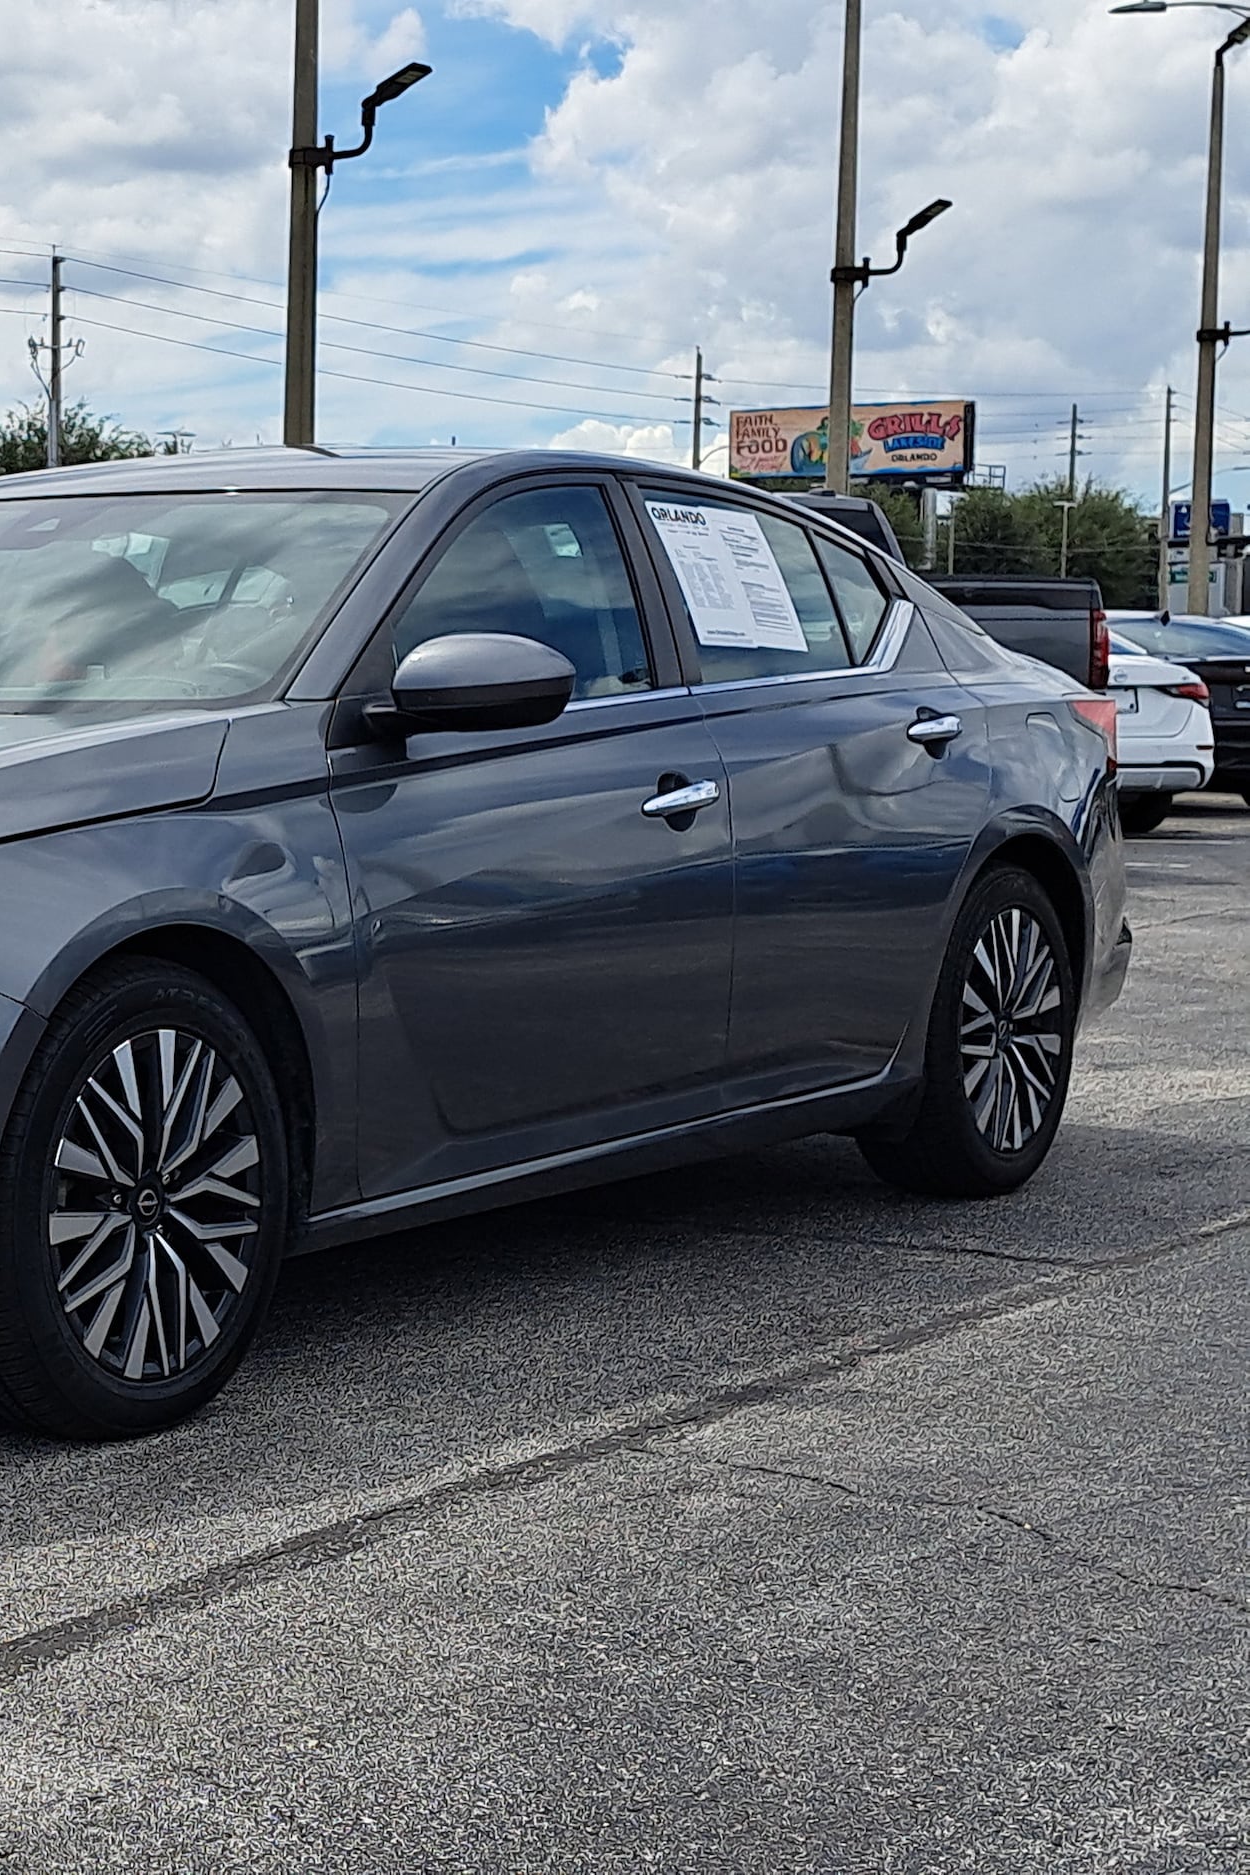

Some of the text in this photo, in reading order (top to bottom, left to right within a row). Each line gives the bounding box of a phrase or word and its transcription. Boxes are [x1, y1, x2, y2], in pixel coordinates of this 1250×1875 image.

[868, 413, 963, 442] GRILLS
[736, 438, 788, 455] FOOD
[891, 453, 938, 462] ORLANDO
[650, 506, 707, 526] ORLANDO
